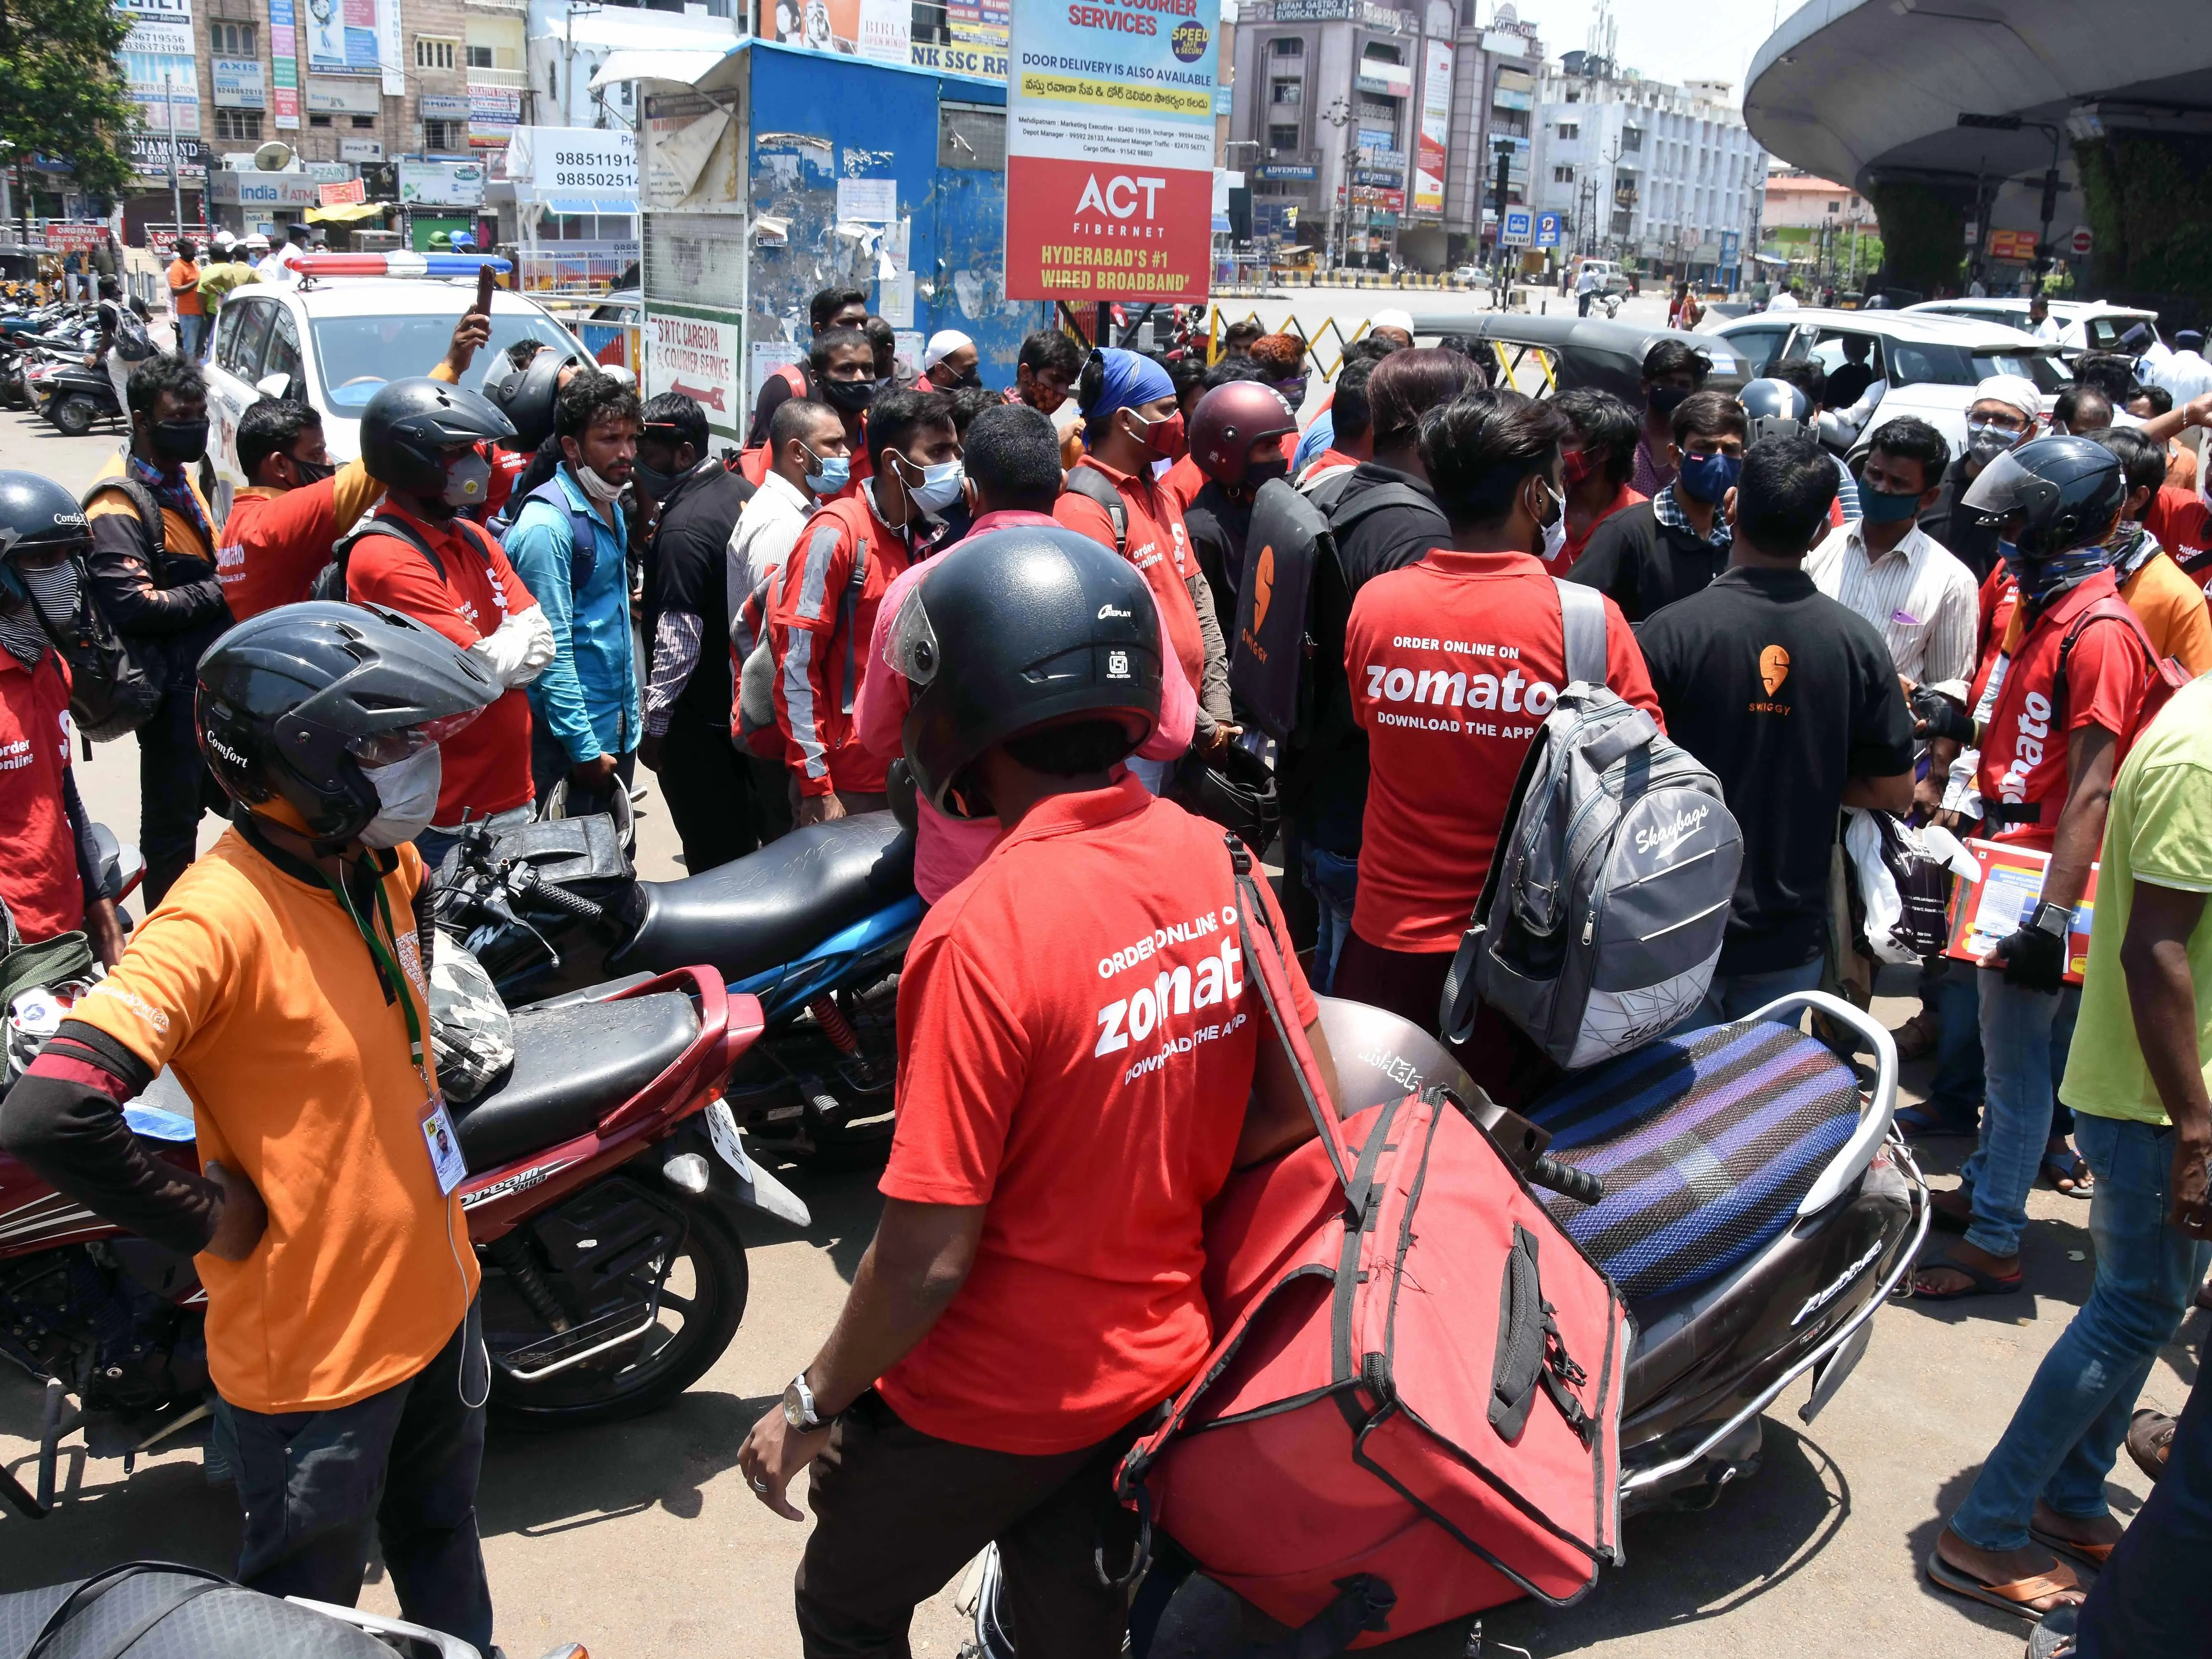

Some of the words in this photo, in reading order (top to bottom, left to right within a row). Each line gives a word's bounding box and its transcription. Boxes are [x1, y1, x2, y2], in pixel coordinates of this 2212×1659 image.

[1068, 5, 1156, 37] SERVICES
[1277, 9, 1314, 20] SURGICAL
[1316, 8, 1346, 18] CENTRE
[125, 33, 184, 44] 896719556
[865, 20, 907, 37] BIRLA
[1173, 27, 1209, 42] SPEED
[119, 41, 185, 53] 036373199
[865, 36, 884, 45] OPEN
[885, 38, 907, 49] MINDS
[218, 62, 258, 71] AXIS
[912, 47, 940, 66] NK
[945, 50, 977, 70] SSC
[1023, 53, 1057, 68] DOOR
[1060, 57, 1111, 75] DELIVERY
[1115, 64, 1124, 75] IS
[1126, 66, 1154, 79] ALSO
[1156, 69, 1211, 87] AVAILABLE
[1047, 81, 1076, 93] రవాణా
[1078, 83, 1093, 96] సేవ
[1096, 86, 1103, 97] &
[1018, 116, 1056, 126] Mehdipatnam
[1060, 120, 1087, 130] Marketing
[1153, 129, 1174, 138] Incharge
[1023, 128, 1039, 137] Depot
[1041, 131, 1064, 139] Manager
[1069, 132, 1086, 141] 99592
[1088, 135, 1105, 143] 26133,
[1106, 136, 1130, 144] Assistant
[1131, 138, 1153, 147] Manager
[241, 184, 277, 201] india
[290, 189, 313, 201] ATM
[1075, 172, 1166, 219] ACT
[1073, 222, 1164, 238] FIBERNET
[1041, 245, 1147, 268] HYDERABAD'S
[1152, 251, 1168, 268] #1
[1041, 269, 1091, 289] WIRED
[651, 317, 681, 345] SRTC
[683, 322, 707, 350] CARGO
[665, 347, 698, 373] COURIER
[700, 353, 729, 381] SERVICE
[501, 453, 521, 462] order
[502, 459, 527, 469] online
[1133, 542, 1156, 559] order
[1135, 552, 1163, 570] online
[1242, 628, 1268, 665] SWIGGY
[1393, 636, 1439, 651] ORDER
[1444, 640, 1495, 657] ONLINE
[1499, 646, 1519, 659] ON
[1367, 665, 1559, 716] zomato
[1748, 702, 1791, 717] SWIGGY
[1378, 711, 1460, 733] DOWNLOAD
[1466, 721, 1496, 737] THE
[1502, 726, 1534, 740] APP
[206, 729, 249, 769] Comfort
[1999, 691, 2052, 833] mato
[2019, 881, 2040, 890] UTHENTIC
[1098, 936, 1155, 979] ORDER
[1155, 911, 1219, 949] ONLINE
[1222, 906, 1237, 925] O
[1095, 935, 1242, 1058] zomat
[1124, 1037, 1192, 1086] DOWNOAD
[1193, 1024, 1218, 1044] THE
[1222, 1013, 1246, 1038] APP
[459, 1165, 540, 1208] Dream
[511, 1174, 547, 1195] Yuga
